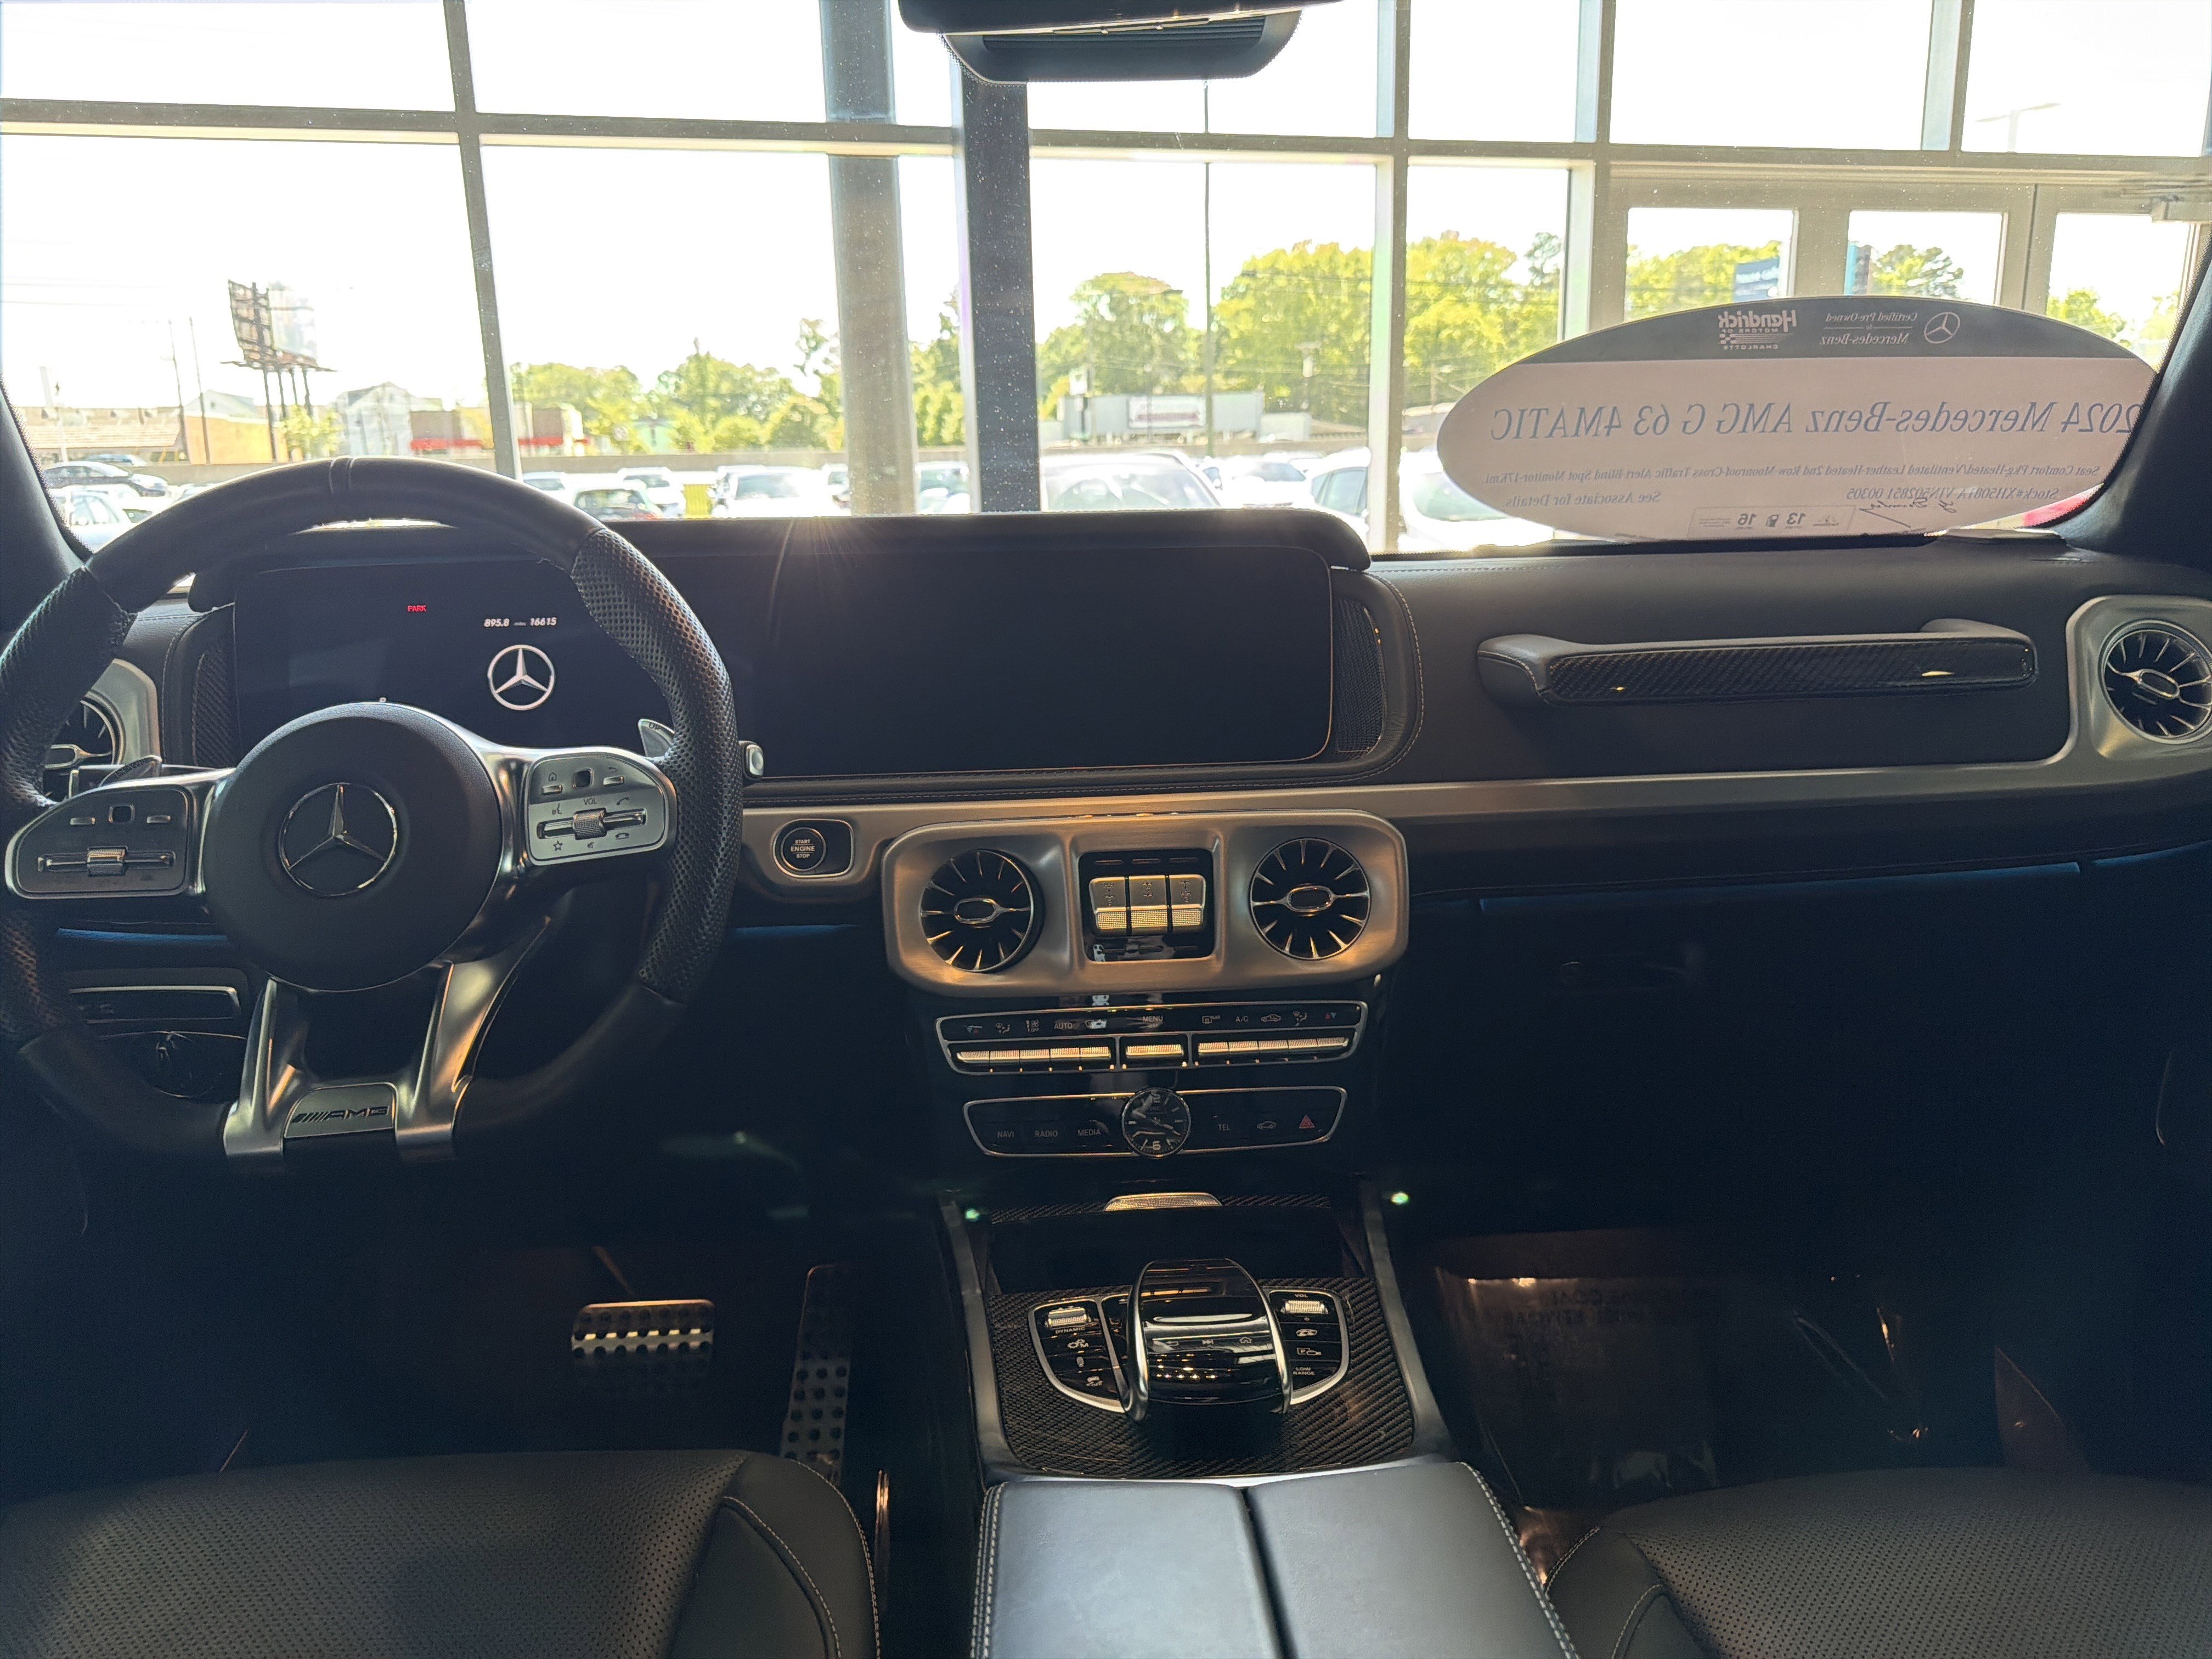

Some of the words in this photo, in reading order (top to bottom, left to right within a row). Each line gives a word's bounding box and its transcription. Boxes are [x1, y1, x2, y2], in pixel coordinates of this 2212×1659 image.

[483, 618, 510, 627] 895.8
[530, 617, 557, 627] 16615
[648, 722, 661, 731] UP
[328, 1106, 389, 1120] AMG
[1153, 1141, 1161, 1150] 6
